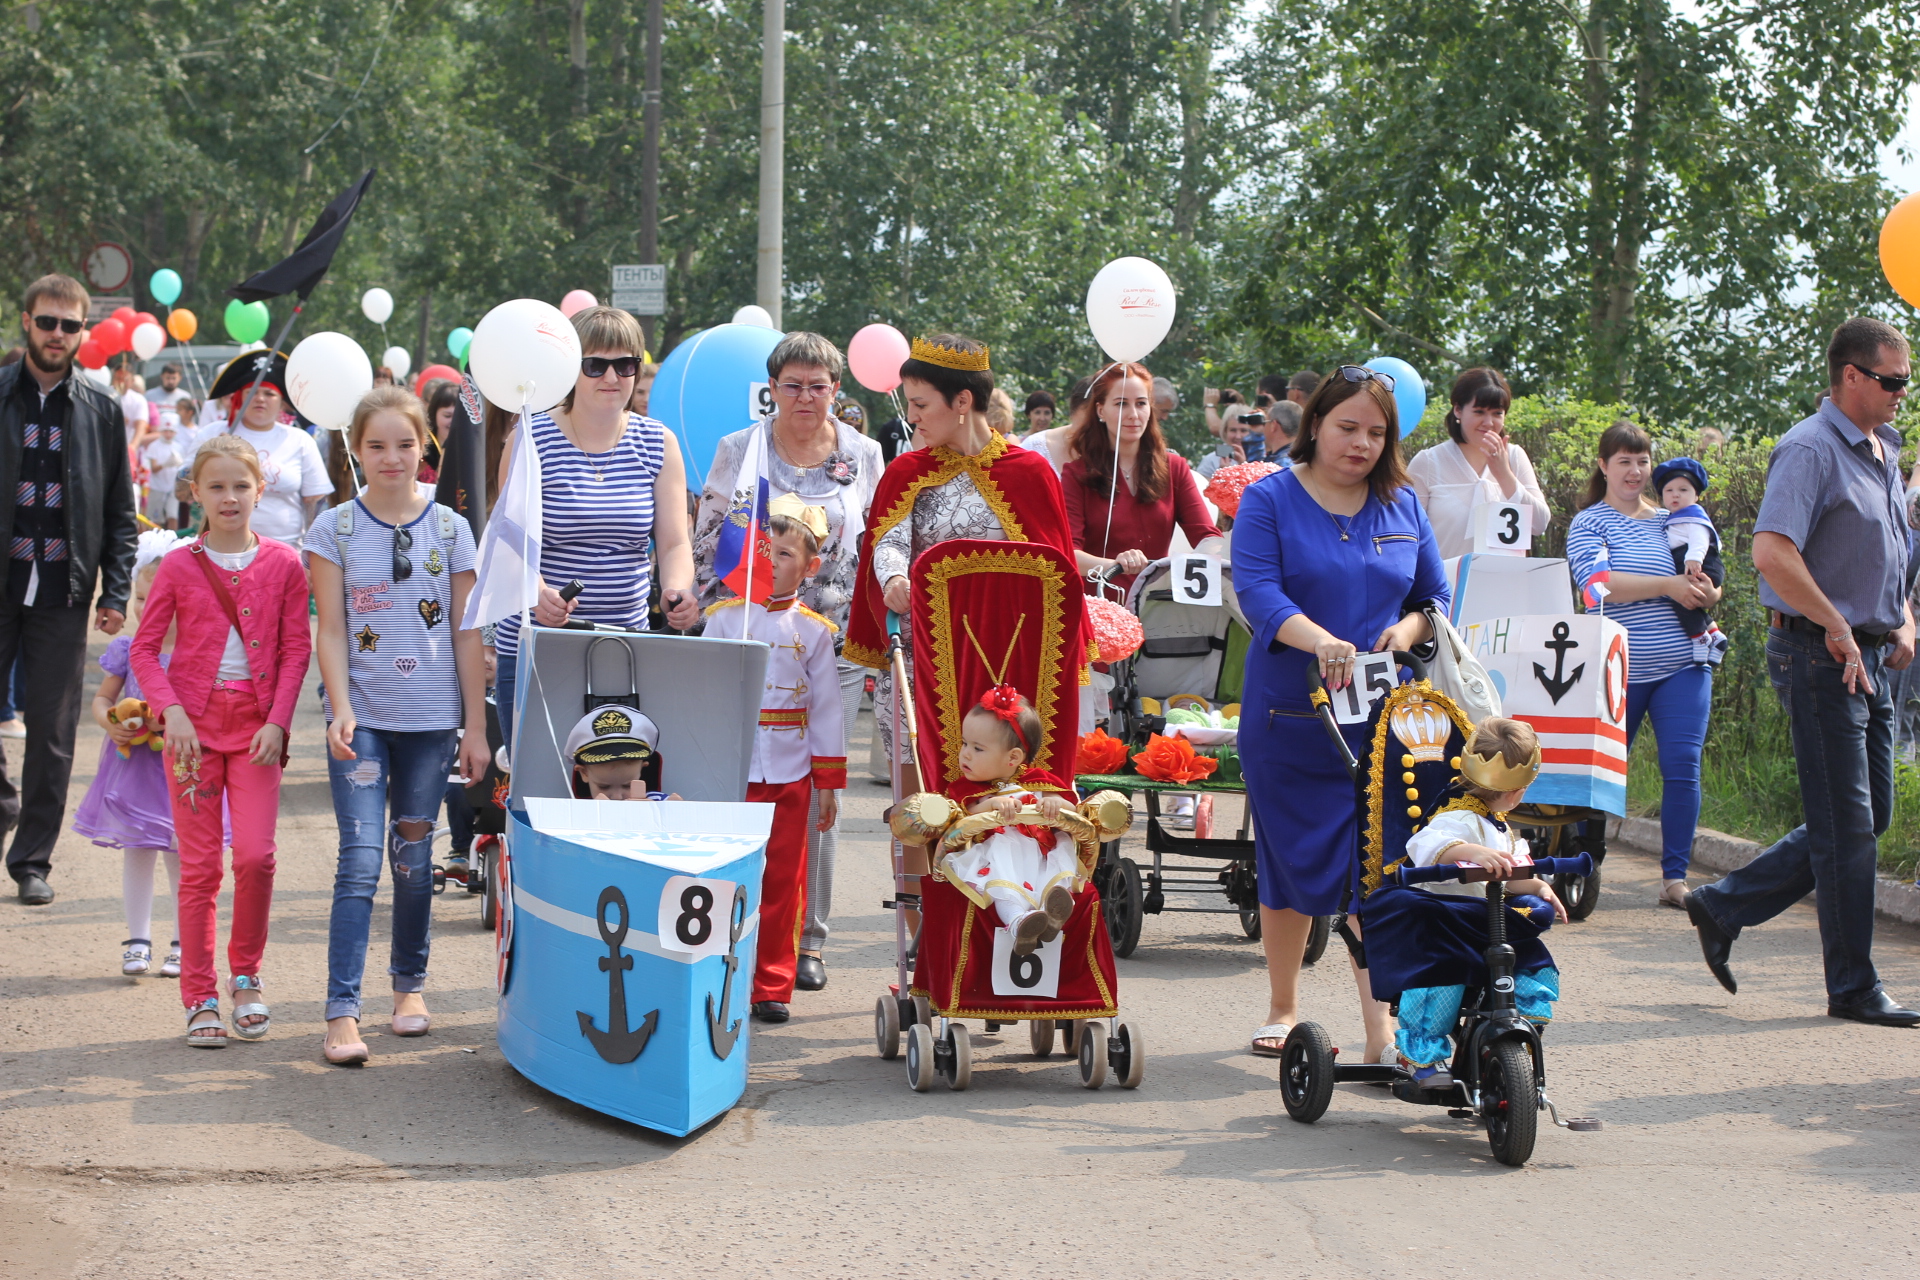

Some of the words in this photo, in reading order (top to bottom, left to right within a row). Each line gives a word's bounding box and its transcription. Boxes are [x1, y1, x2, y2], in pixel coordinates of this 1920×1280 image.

[616, 267, 663, 281] ТЕНТЫ
[1119, 295, 1140, 305] Red
[758, 387, 776, 416] 9
[1497, 507, 1520, 545] 3
[1183, 558, 1209, 600] 5
[1336, 661, 1393, 716] 15
[597, 726, 628, 735] КАПИТАН
[675, 885, 714, 946] 8
[1009, 938, 1044, 989] 6
